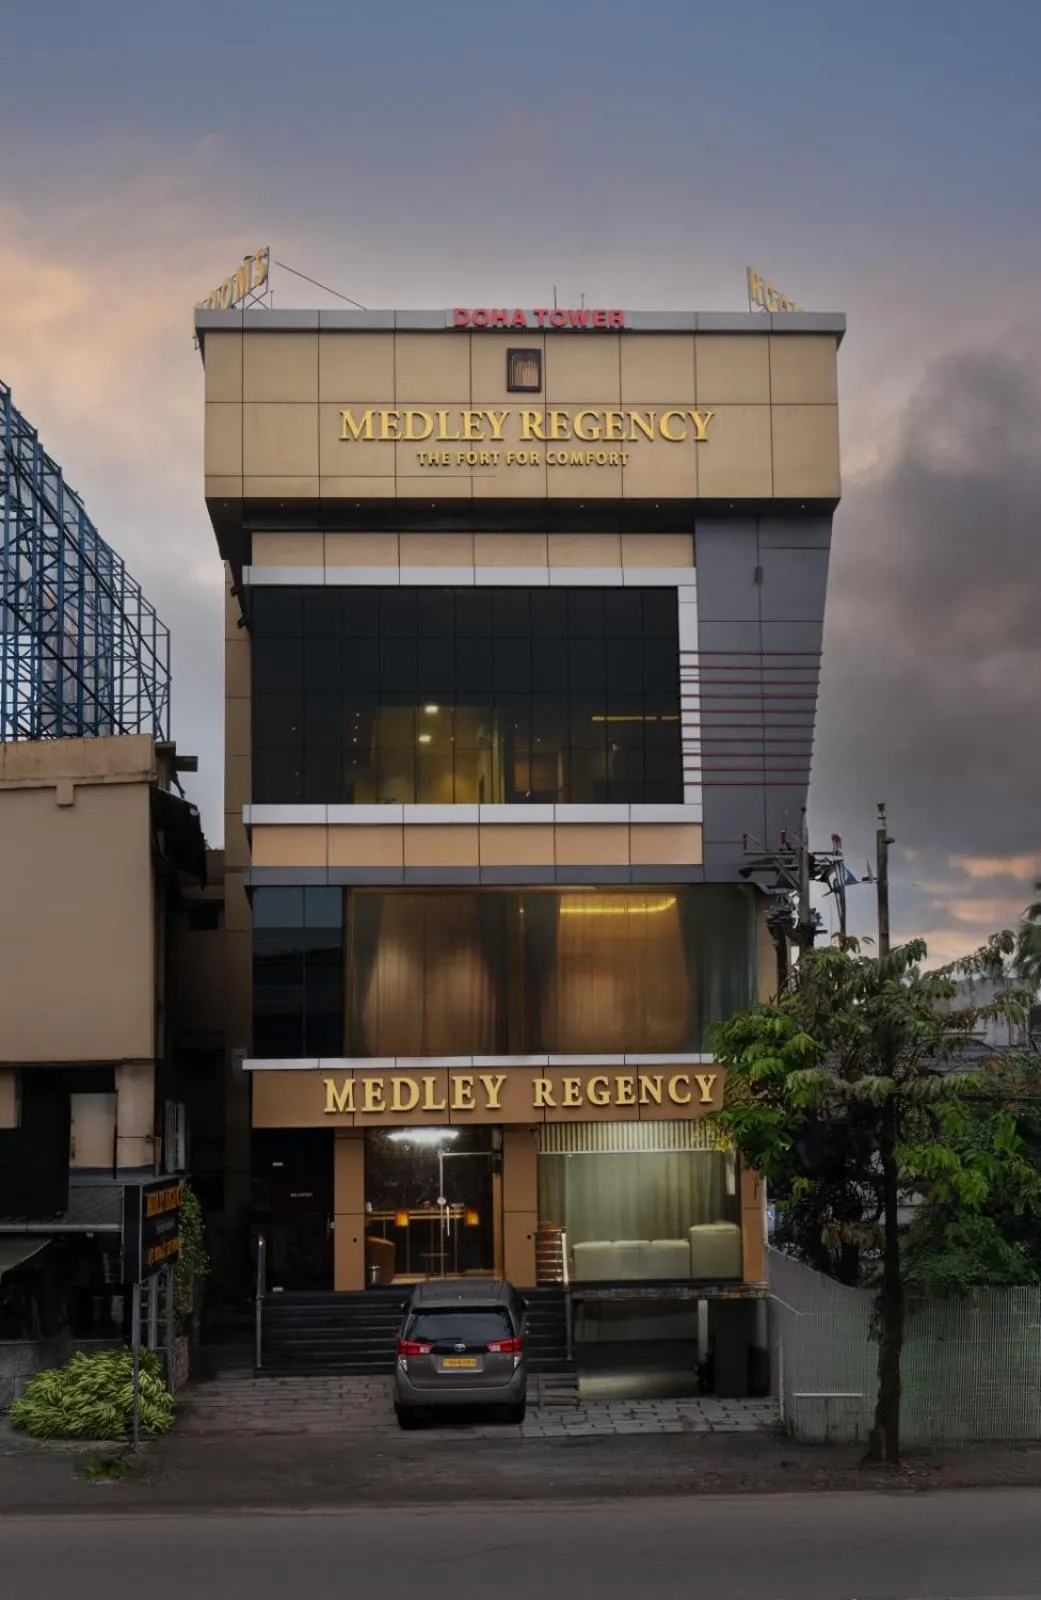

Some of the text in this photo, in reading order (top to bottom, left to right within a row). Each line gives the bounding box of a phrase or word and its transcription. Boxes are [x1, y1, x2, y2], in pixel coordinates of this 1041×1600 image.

[194, 247, 267, 312] OOMS
[453, 308, 625, 328] DOHA TOWER
[338, 408, 715, 442] MEDLEY REGENCY
[417, 451, 630, 467] THE FORT FOR COMFORT
[323, 1074, 717, 1114] MEDLEY REGENCY
